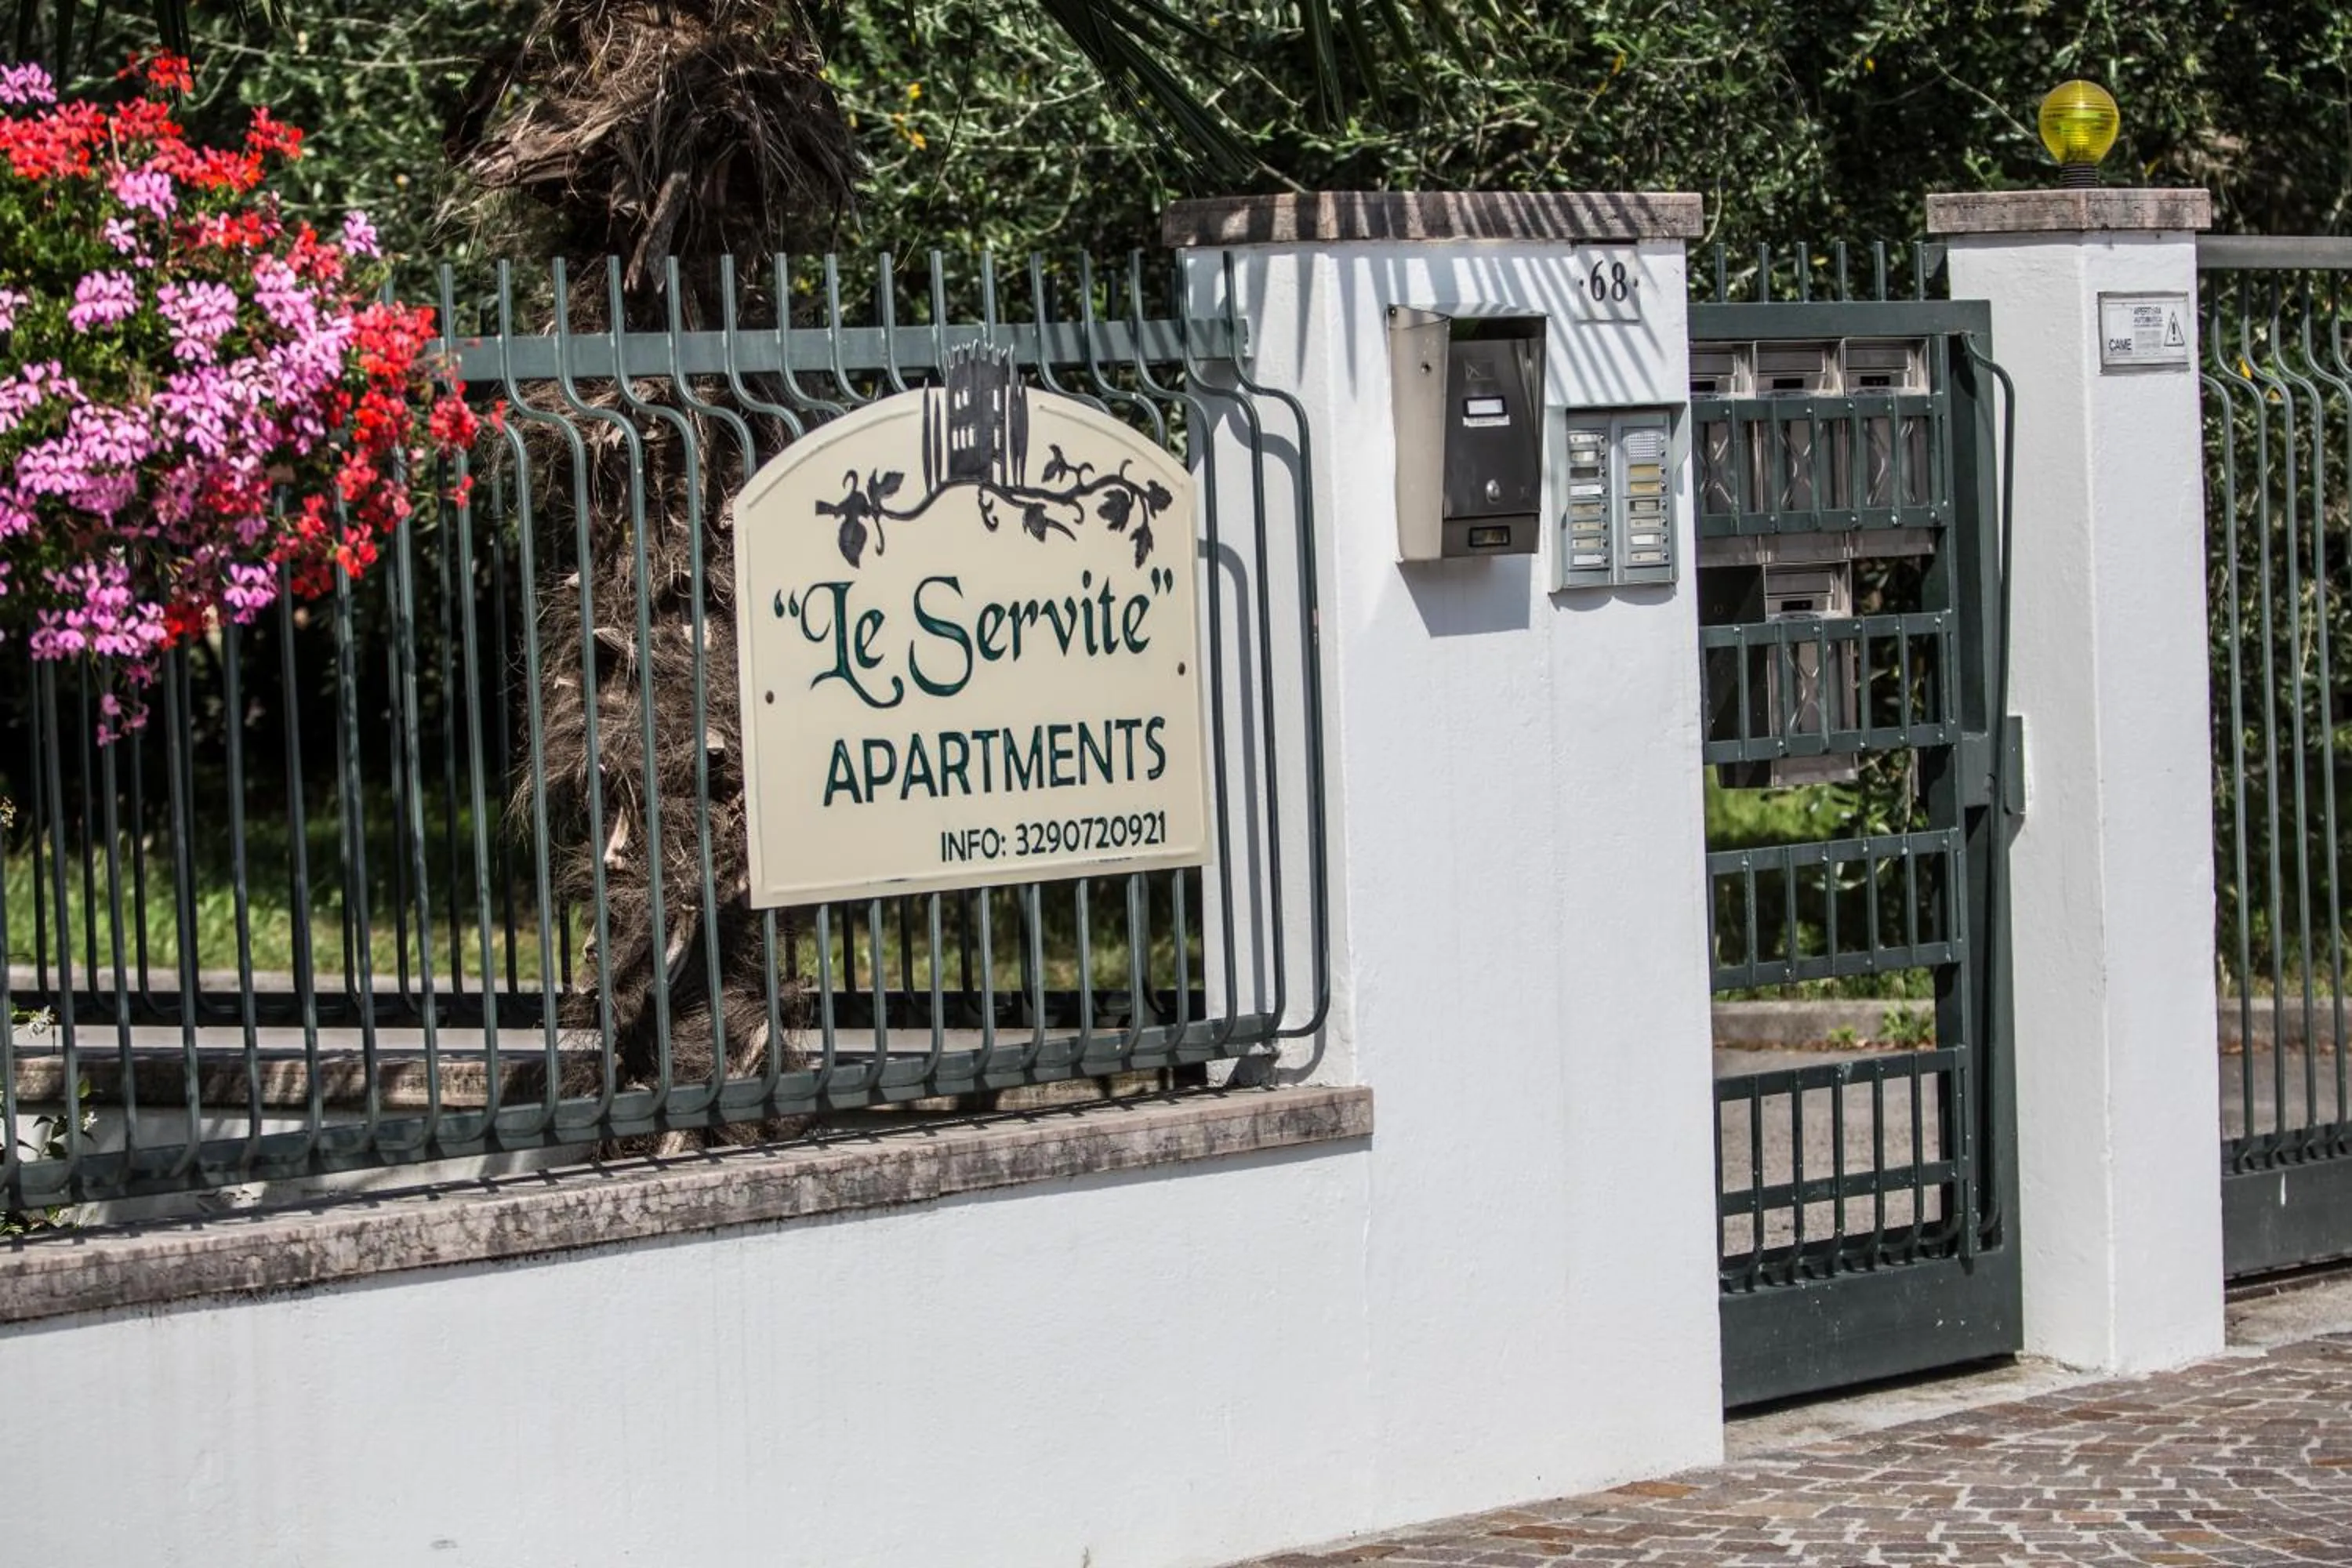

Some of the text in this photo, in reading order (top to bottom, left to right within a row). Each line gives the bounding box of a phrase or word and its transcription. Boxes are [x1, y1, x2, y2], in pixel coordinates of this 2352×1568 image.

[1590, 260, 1628, 302] 68
[823, 716, 1167, 807] APARTMENTS
[941, 811, 1167, 862] INFO: 3290720921
